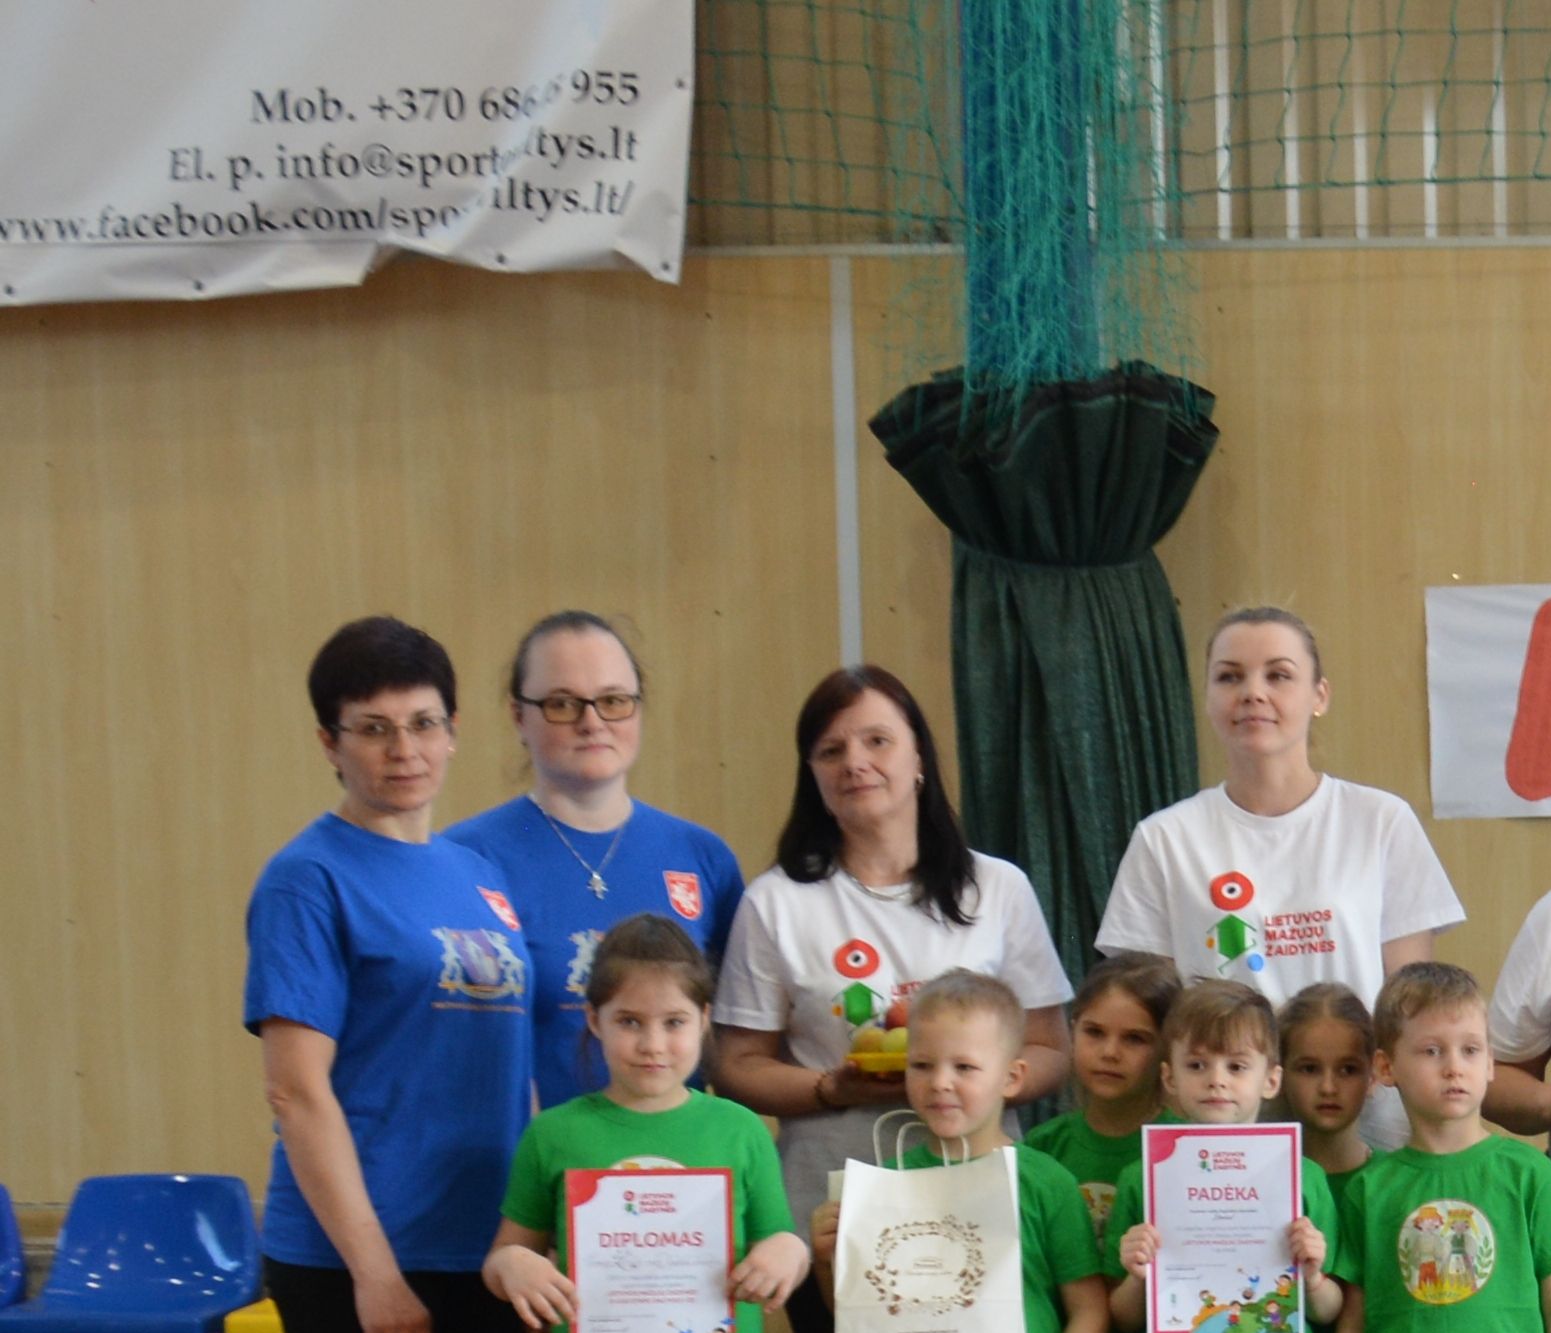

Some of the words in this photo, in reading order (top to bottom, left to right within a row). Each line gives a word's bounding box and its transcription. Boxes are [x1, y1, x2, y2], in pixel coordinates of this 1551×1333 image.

[250, 88, 355, 125] Mob.
[368, 86, 466, 122] +370
[169, 146, 214, 183] El.
[228, 160, 264, 191] p.
[1187, 1184, 1260, 1201] PADĖKA
[598, 1231, 704, 1248] DIPLOMAS
